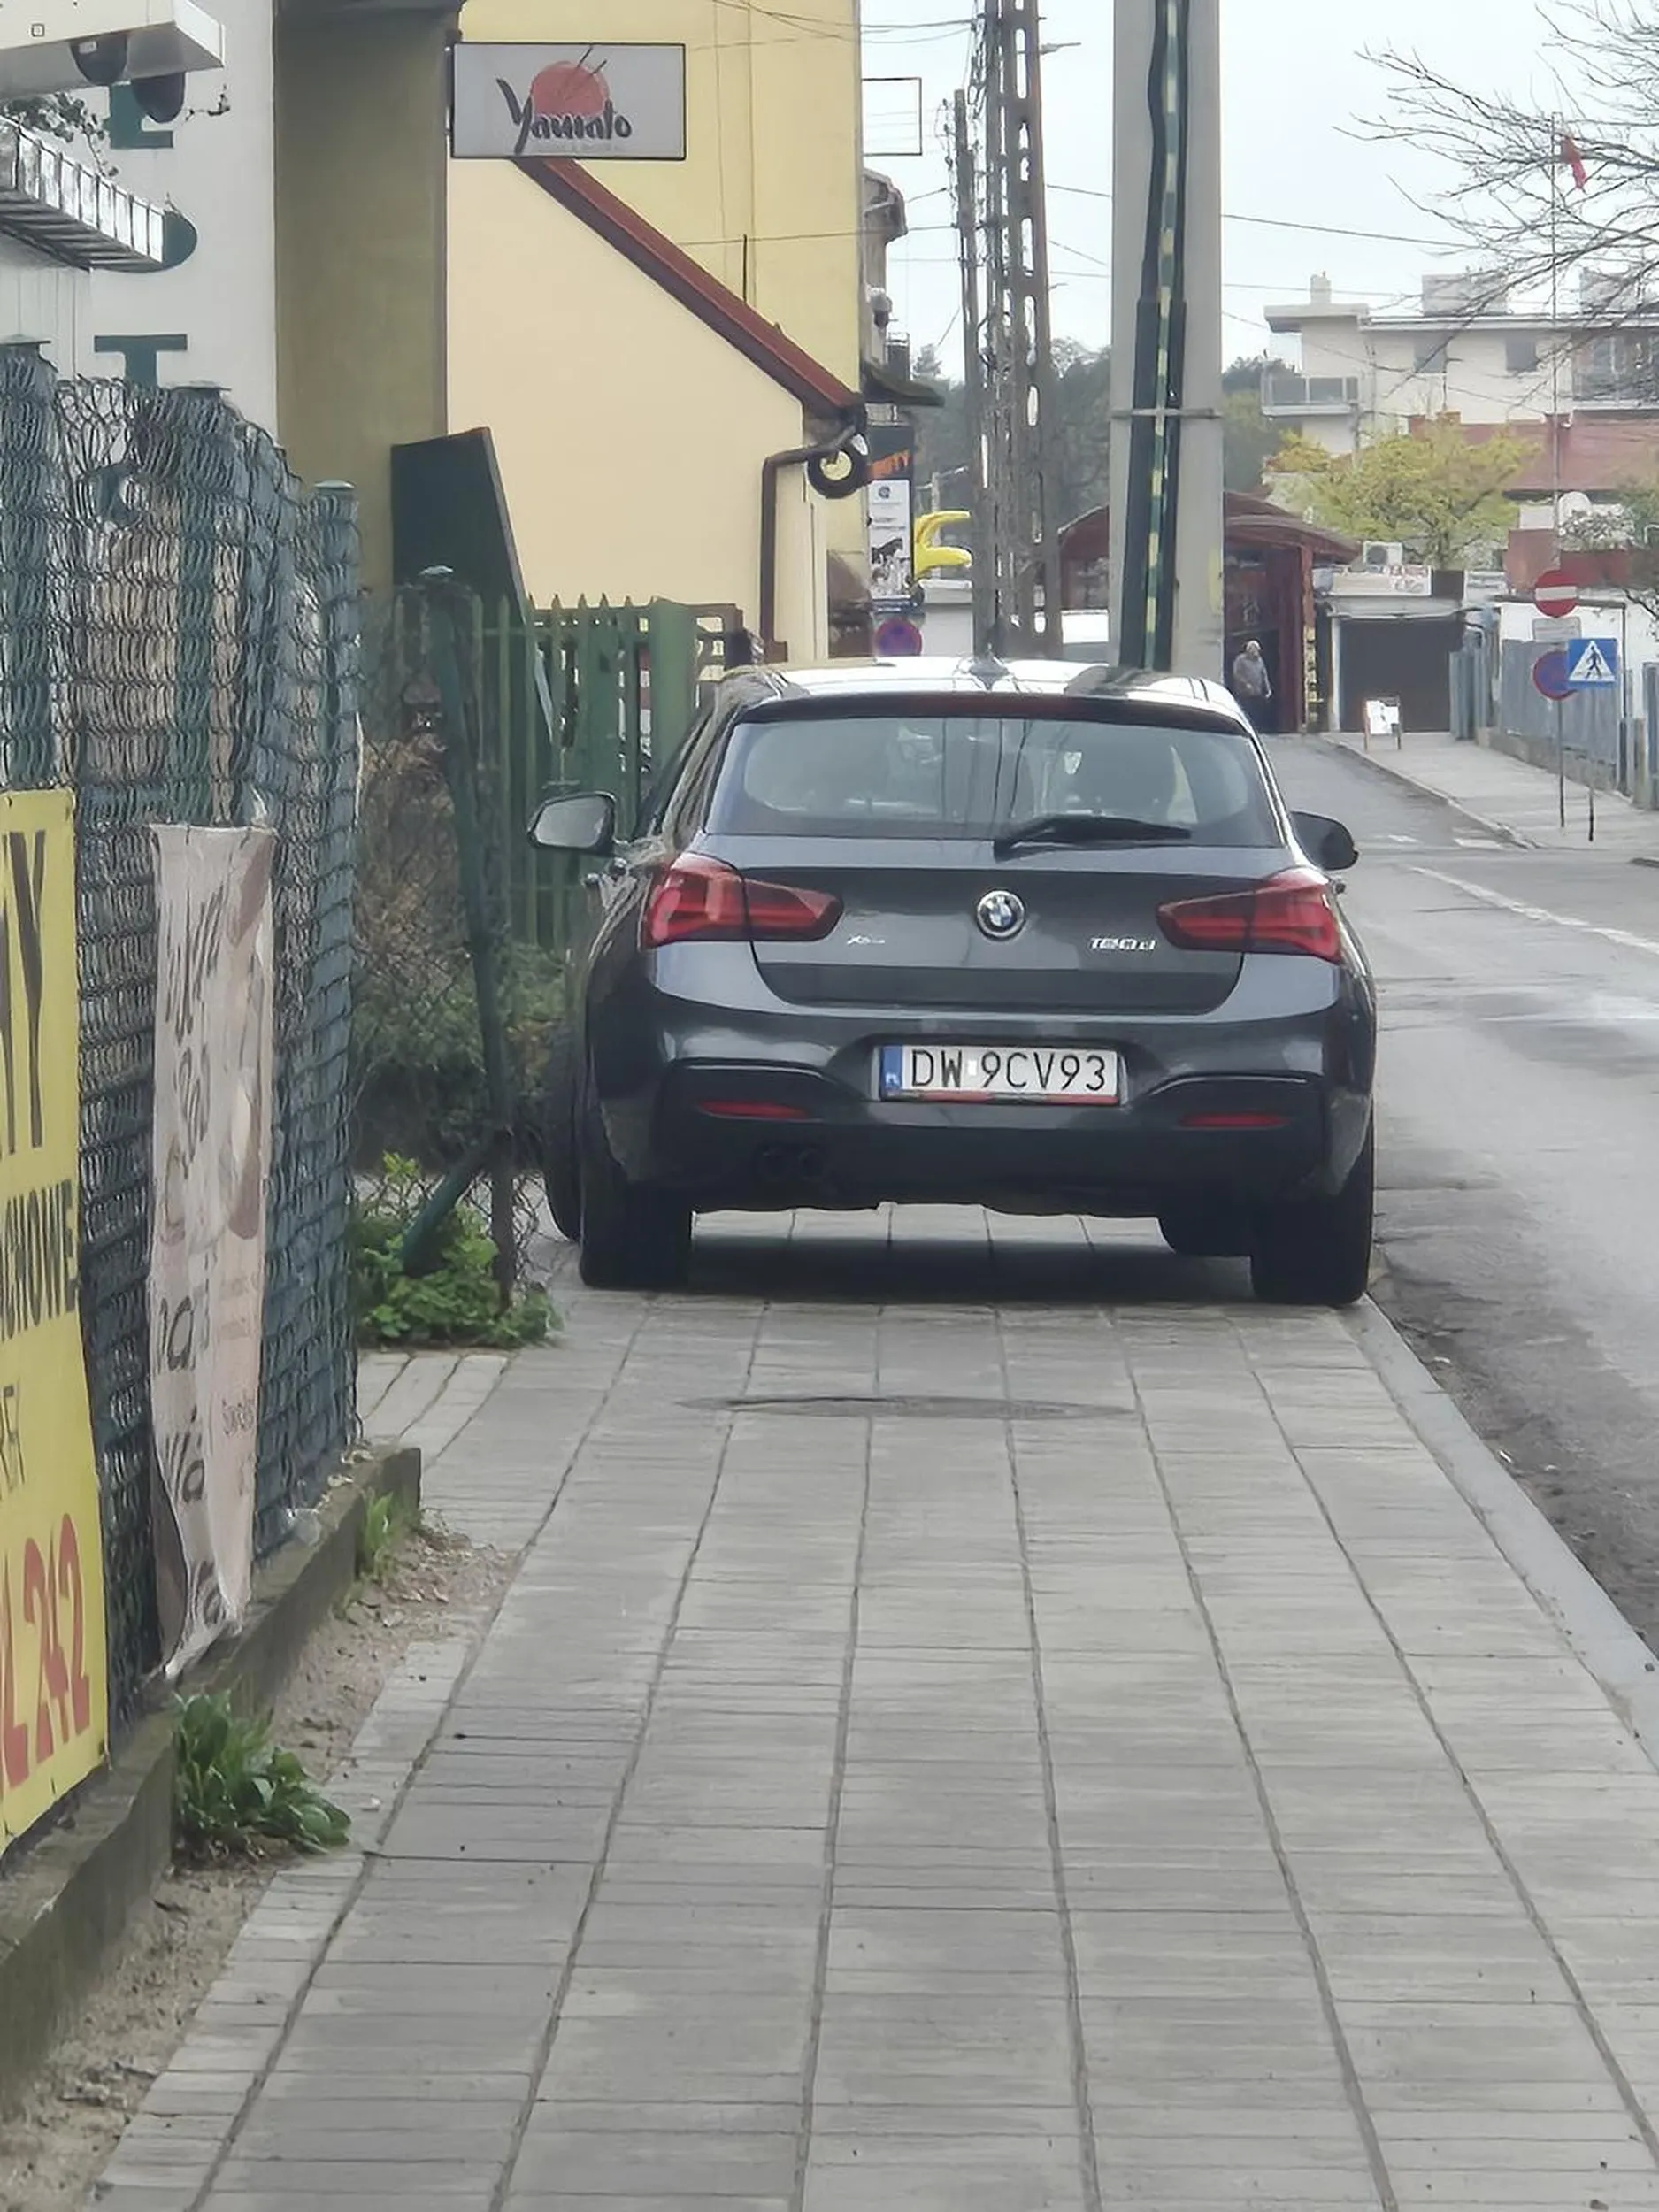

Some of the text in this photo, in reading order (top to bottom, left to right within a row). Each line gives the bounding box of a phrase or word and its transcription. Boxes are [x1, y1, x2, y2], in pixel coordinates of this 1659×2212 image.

[911, 1049, 963, 1087] DW
[980, 1050, 1106, 1091] 9CV93
[0, 1179, 74, 1344] CHOWE
